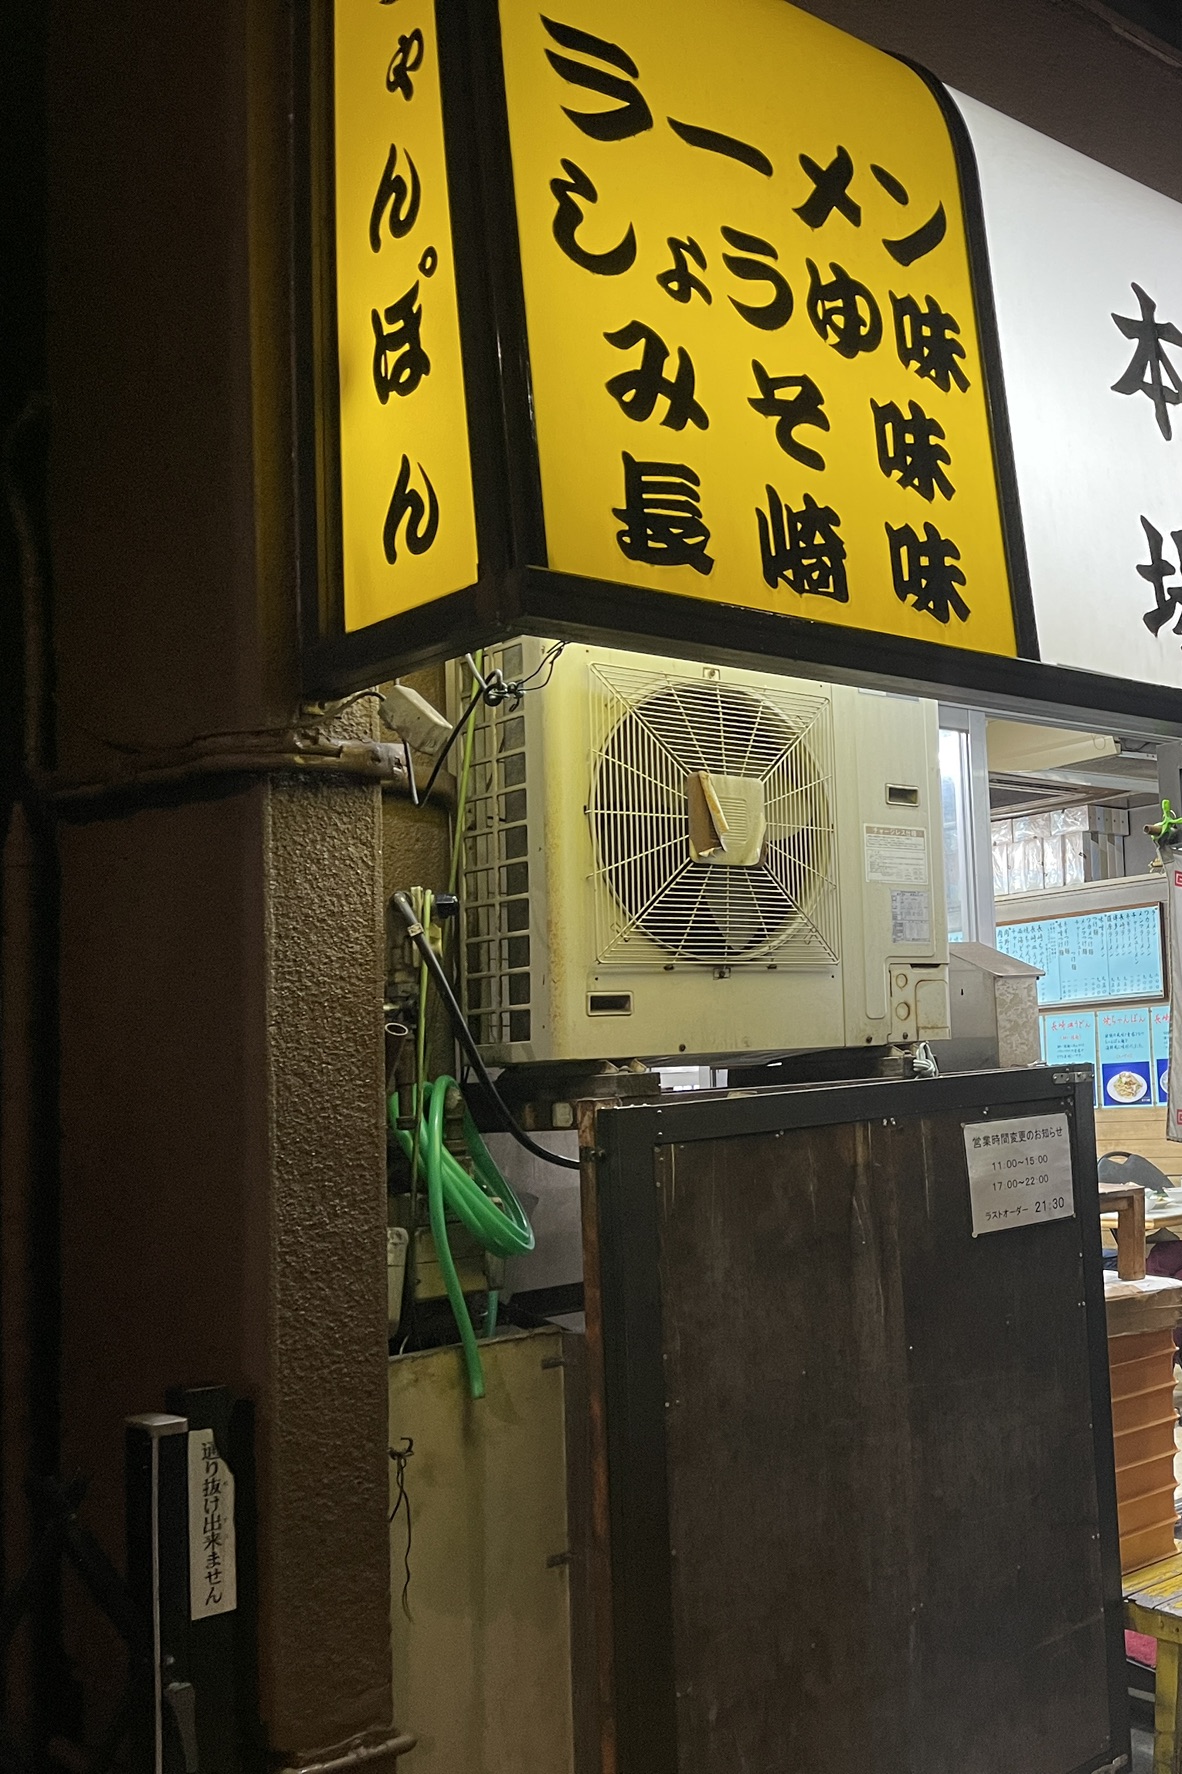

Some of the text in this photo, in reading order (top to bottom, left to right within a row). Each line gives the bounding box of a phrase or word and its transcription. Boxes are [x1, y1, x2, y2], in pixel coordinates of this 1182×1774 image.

[539, 13, 947, 266] ラーメン
[371, 0, 440, 566] ゃんぽん
[548, 158, 971, 394] しょうゆ味
[602, 319, 956, 501] みそ味
[610, 450, 972, 623] 長崎味
[972, 1126, 1063, 1148] 営業時間変更のお知らせ
[985, 1196, 1065, 1221] ラストオーダー 21:30
[201, 1442, 223, 1606] 通り抜け出来ません
